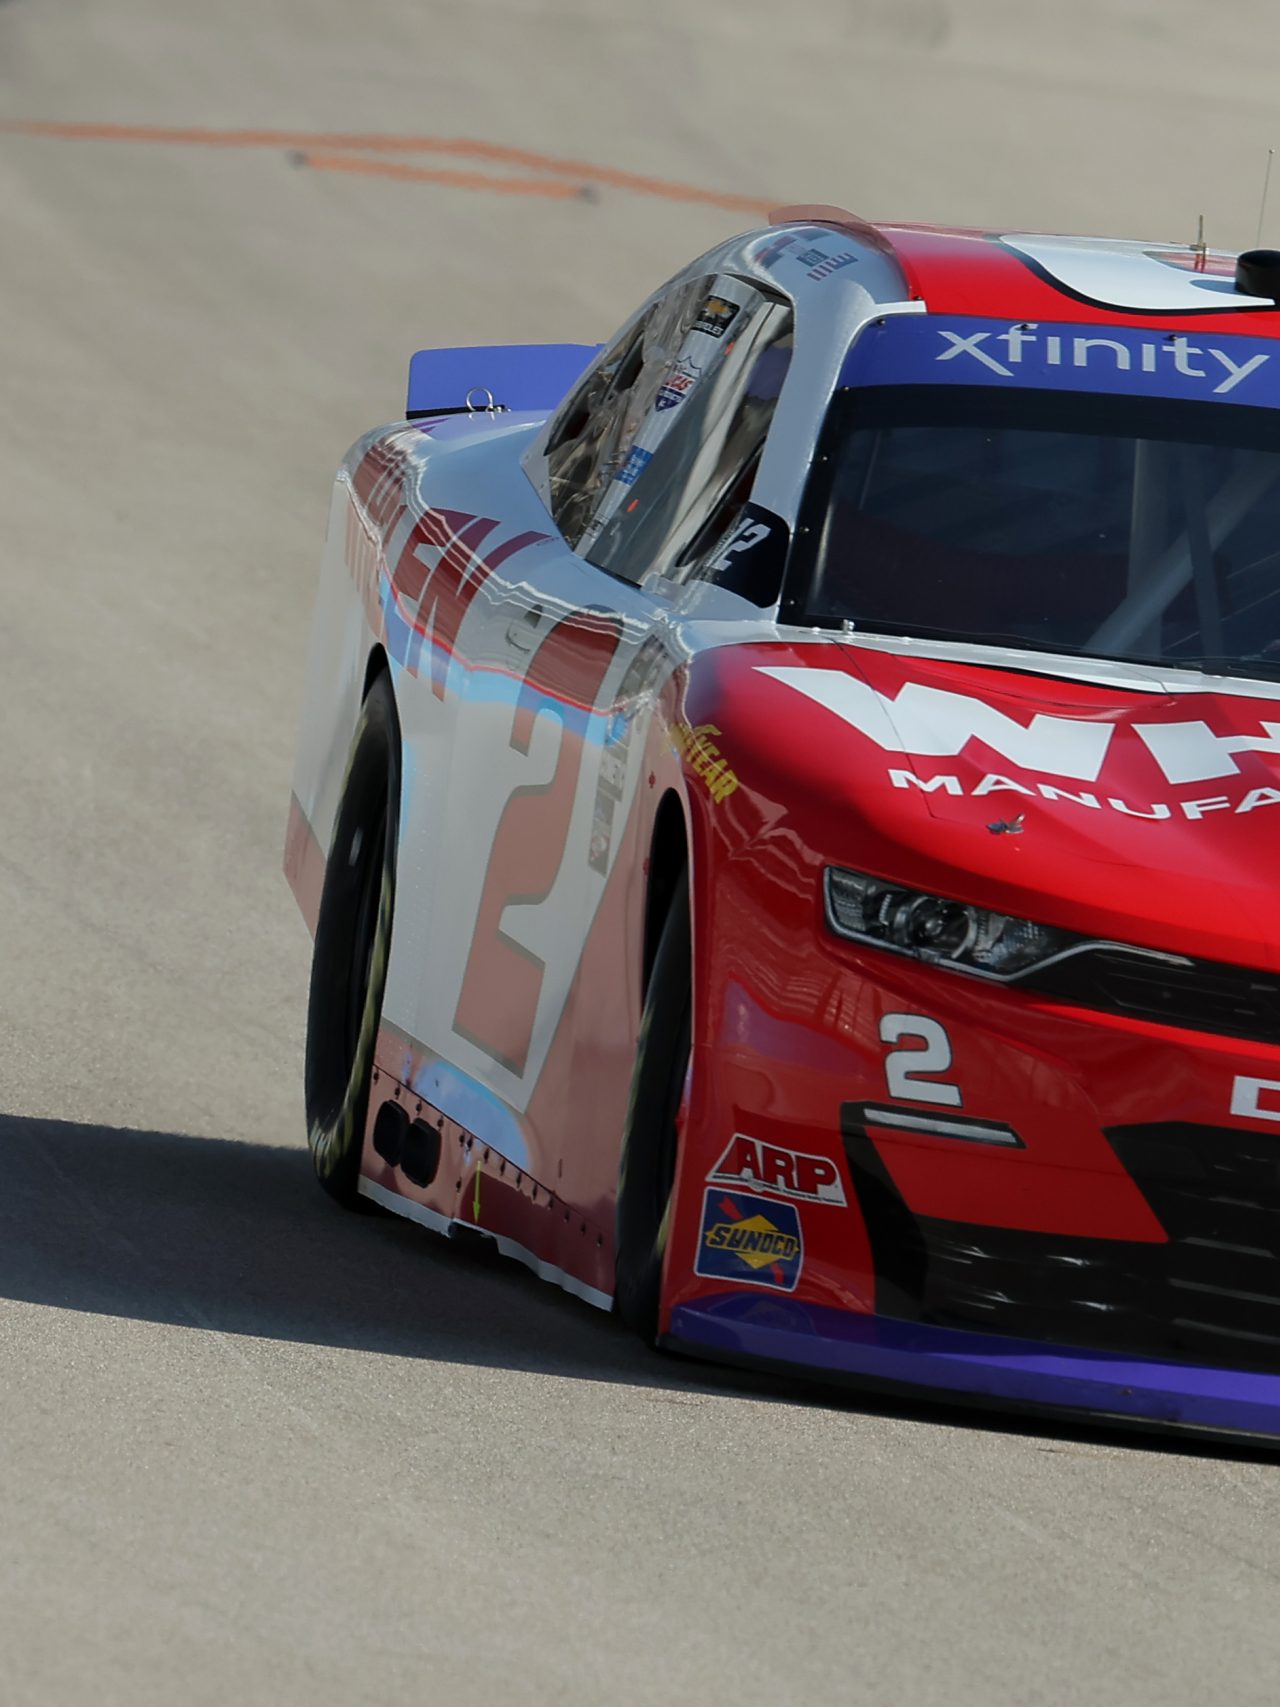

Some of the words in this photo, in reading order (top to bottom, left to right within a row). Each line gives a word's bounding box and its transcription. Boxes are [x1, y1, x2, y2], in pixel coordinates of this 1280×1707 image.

[935, 323, 1270, 393] xfinity
[452, 603, 625, 1079] 2
[879, 1013, 963, 1108] 2
[712, 1136, 837, 1197] ARP
[708, 1224, 798, 1259] SUNOCO
